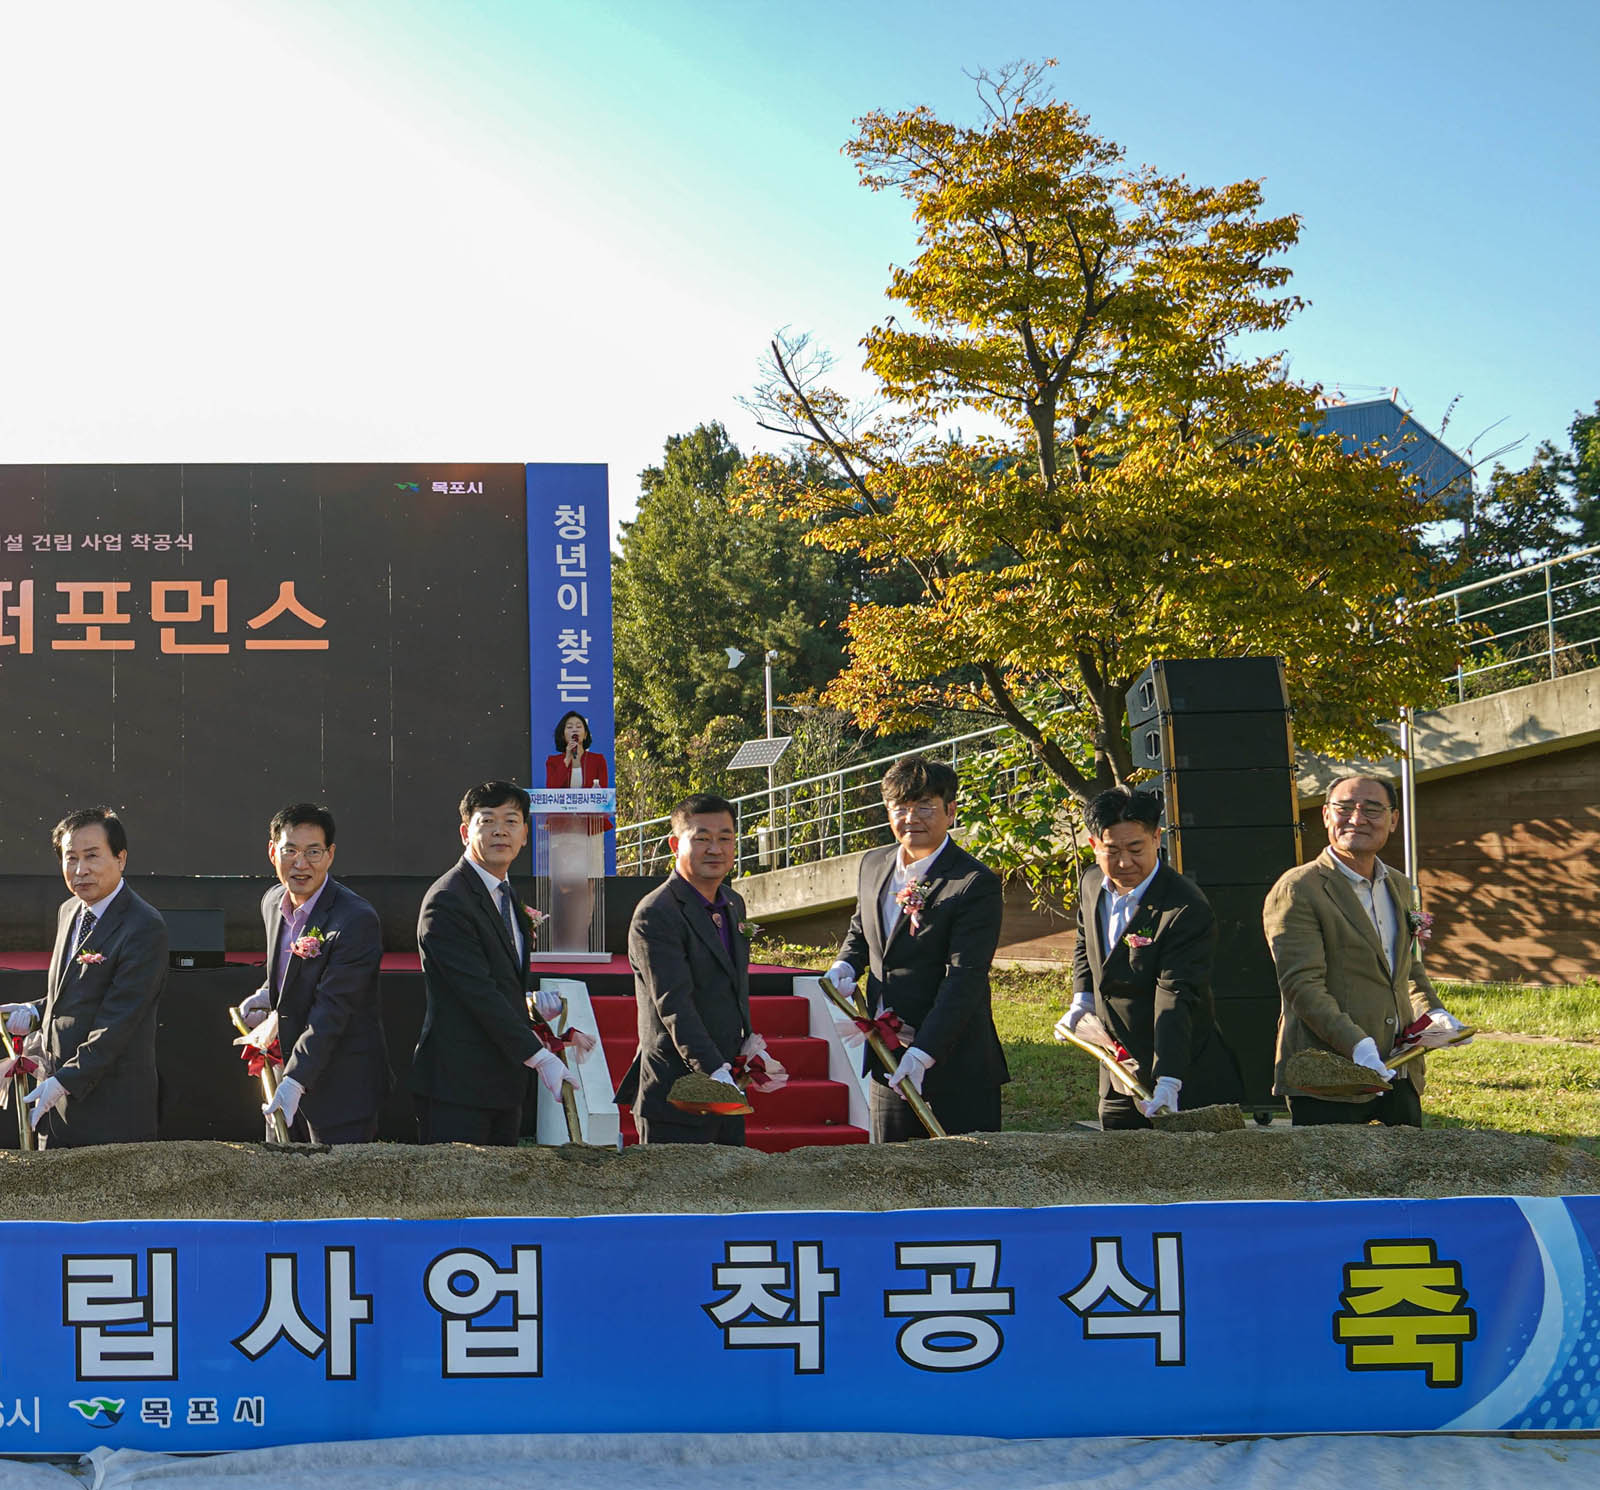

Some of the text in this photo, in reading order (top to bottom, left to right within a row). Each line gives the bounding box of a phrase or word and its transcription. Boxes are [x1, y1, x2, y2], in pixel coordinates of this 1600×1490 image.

[32, 533, 73, 552] 건립
[80, 533, 123, 552] 사업
[130, 532, 194, 552] 착공식
[431, 481, 483, 495] 목포시
[554, 505, 592, 702] 청년이 찾는
[701, 1231, 1186, 1375] 착공식
[1332, 1238, 1476, 1388] 축
